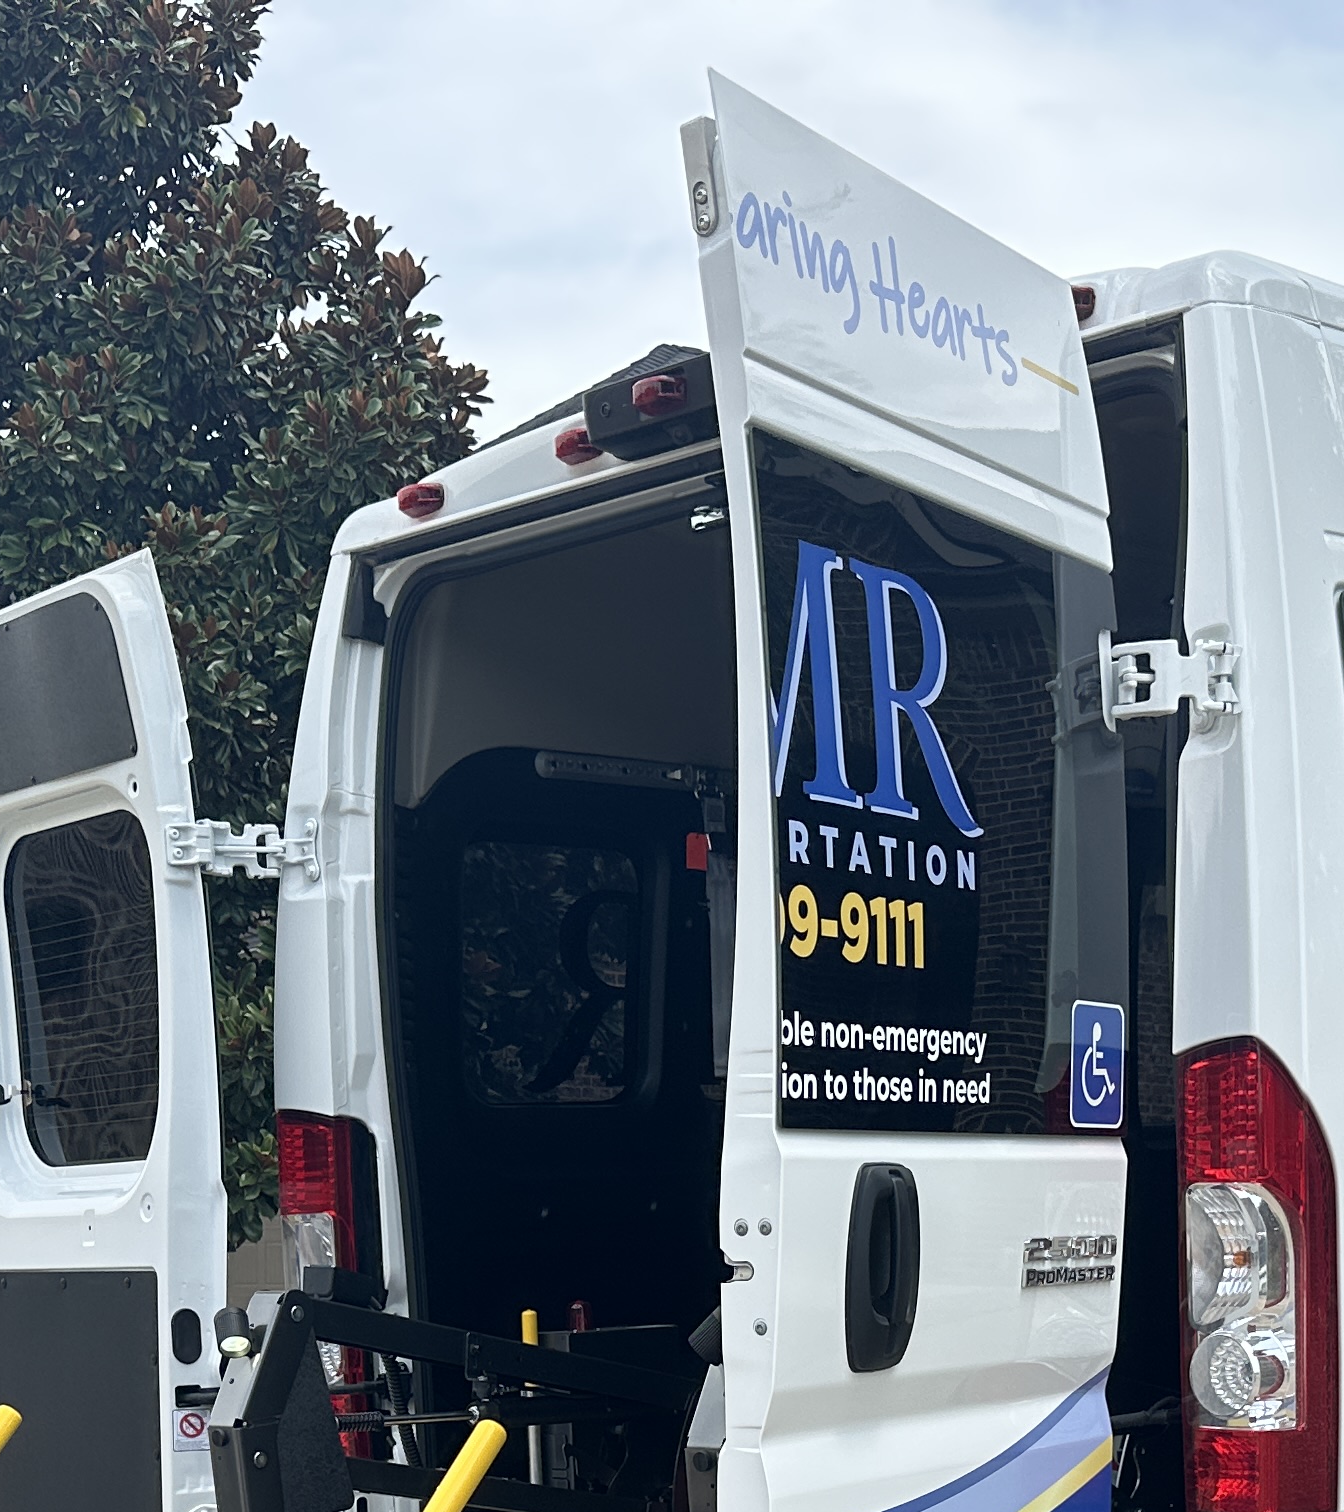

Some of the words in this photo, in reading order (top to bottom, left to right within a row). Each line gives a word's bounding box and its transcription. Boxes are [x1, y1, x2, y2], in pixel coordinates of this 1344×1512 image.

[729, 192, 862, 335] aring
[869, 236, 1018, 387] Hearts
[787, 819, 976, 891] RTATION
[779, 883, 925, 969] 9-9111
[821, 1019, 987, 1064] non-emergency
[781, 1061, 817, 1099] ion
[824, 1068, 848, 1100] to
[853, 1067, 913, 1102] those
[918, 1068, 937, 1103] in
[943, 1072, 991, 1104] need
[1023, 1234, 1118, 1263] 2500
